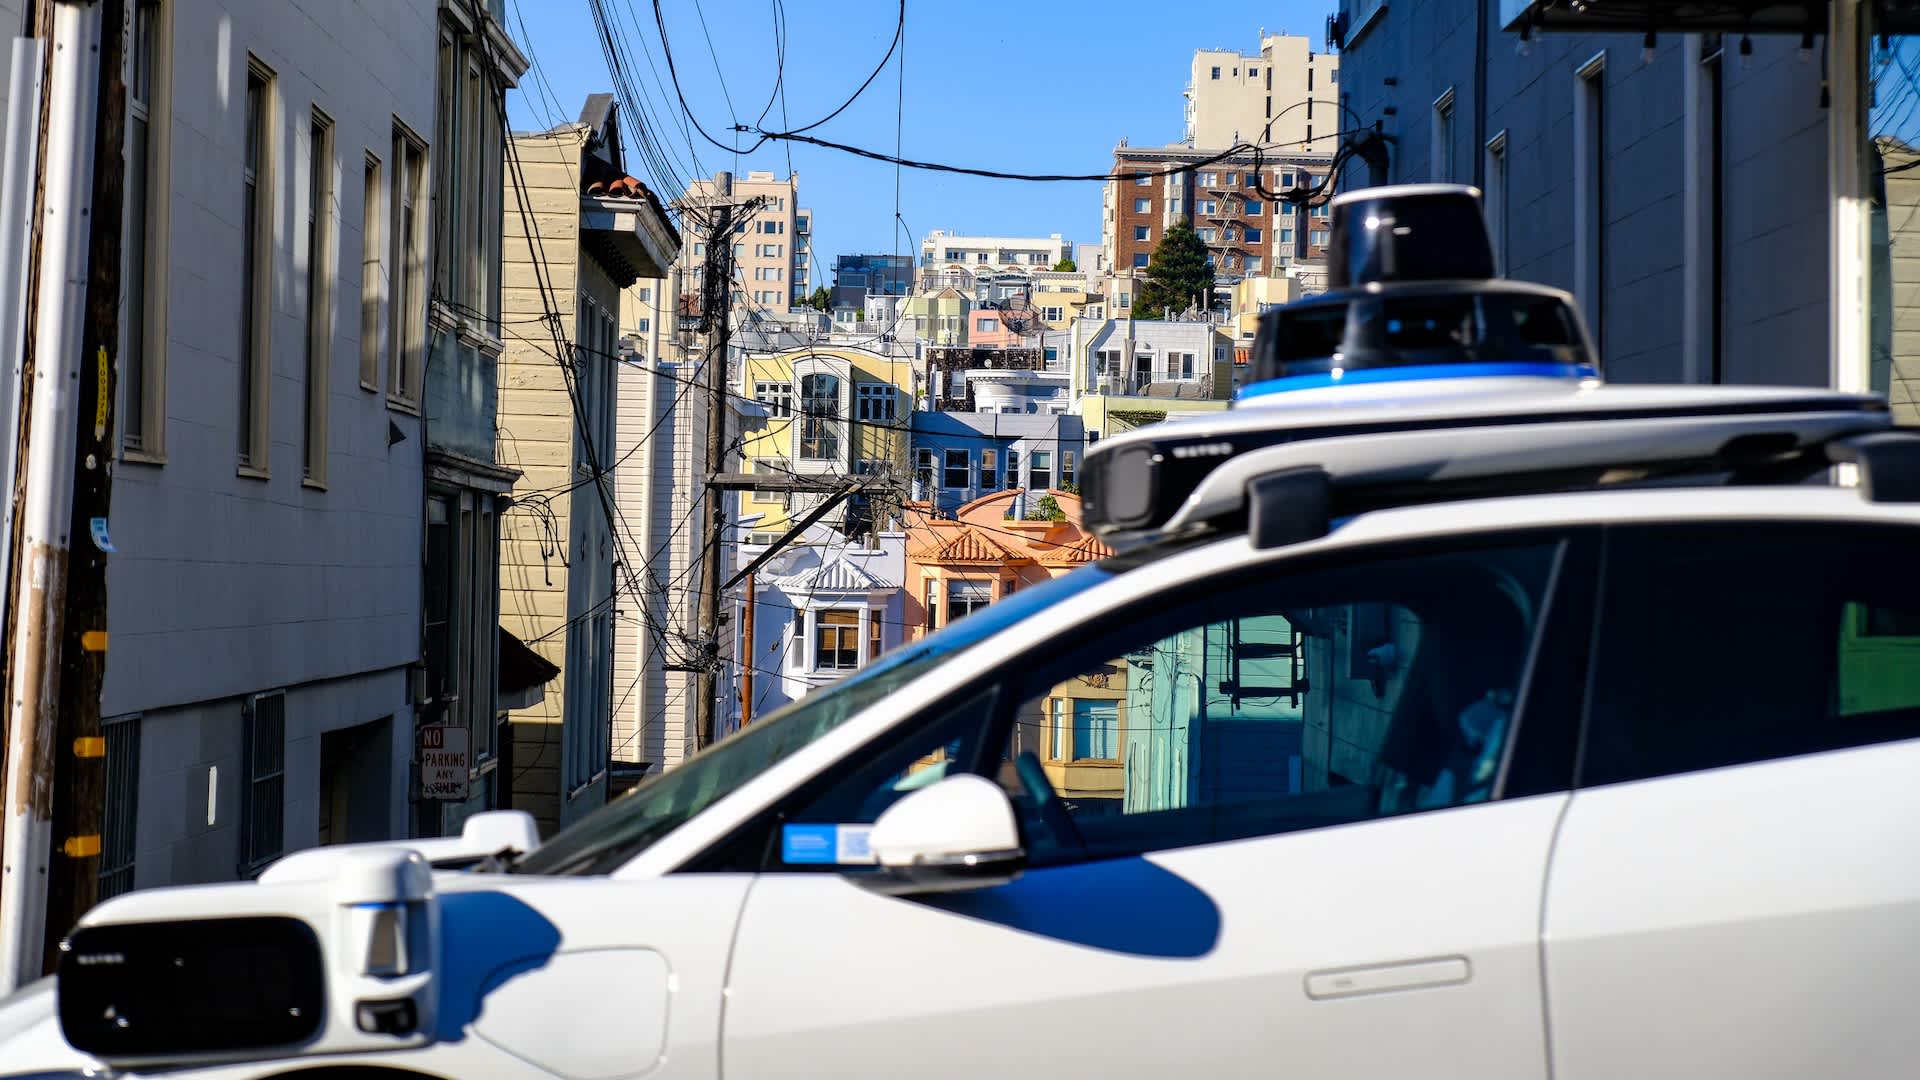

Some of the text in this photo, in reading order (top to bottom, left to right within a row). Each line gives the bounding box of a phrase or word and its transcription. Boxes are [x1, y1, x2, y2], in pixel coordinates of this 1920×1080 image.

[424, 729, 441, 746] NO
[425, 753, 465, 768] PARKING
[436, 769, 455, 780] ANY
